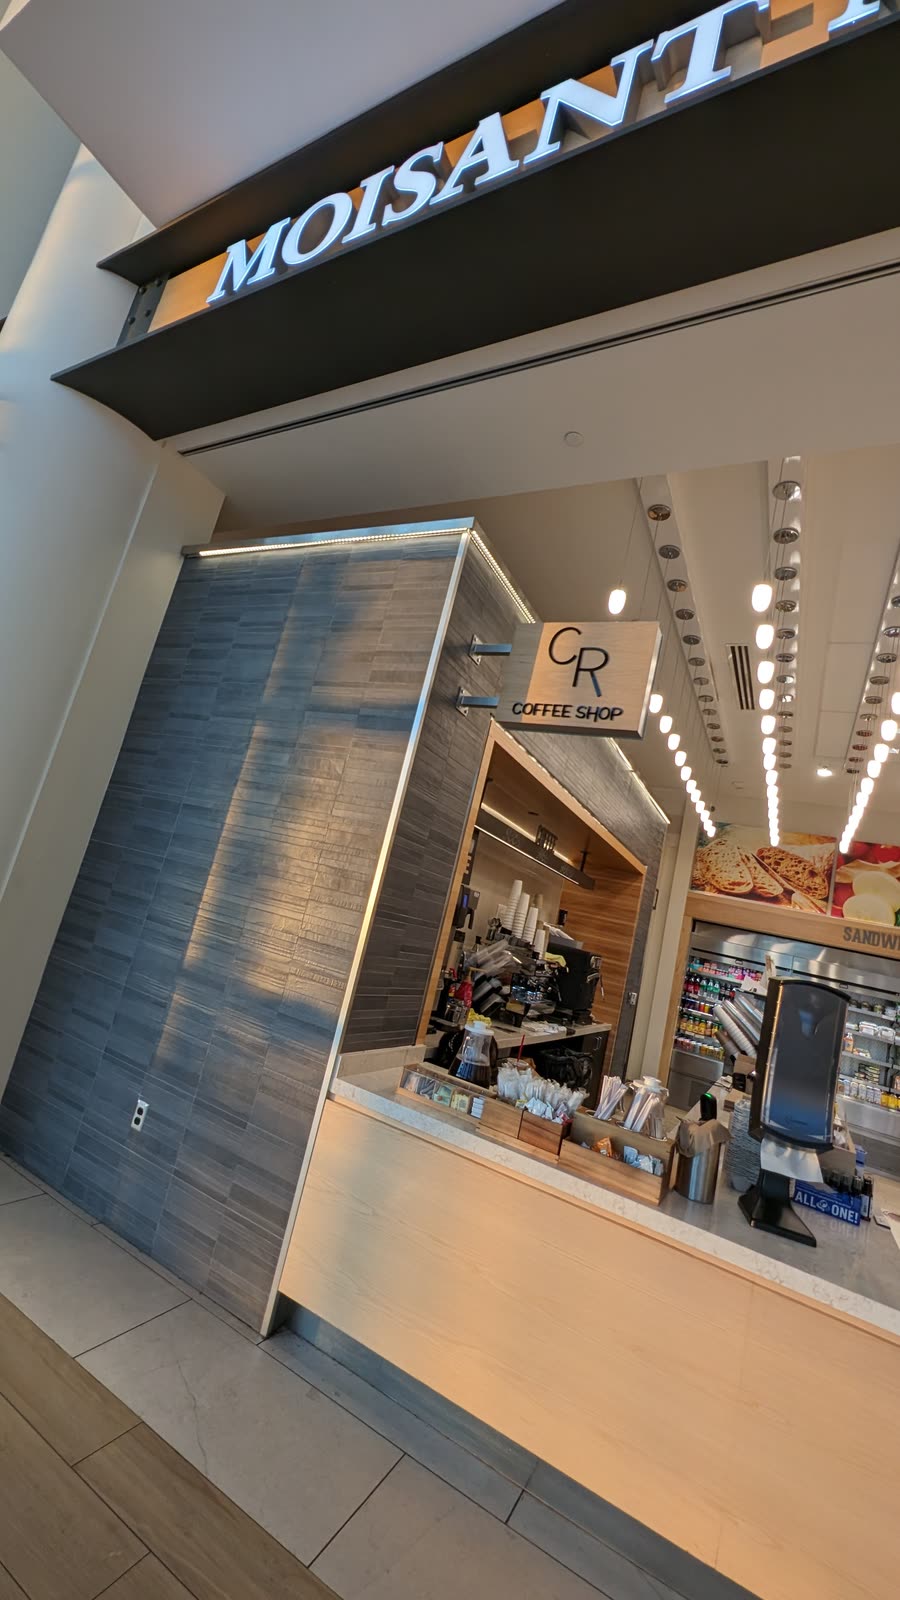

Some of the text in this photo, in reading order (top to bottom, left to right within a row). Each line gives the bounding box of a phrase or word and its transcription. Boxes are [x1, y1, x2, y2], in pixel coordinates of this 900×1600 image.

[206, 0, 770, 303] MOISANT
[511, 702, 624, 723] COFFEE SHOP
[794, 1191, 816, 1209] ALL
[831, 1204, 859, 1224] ONE!
